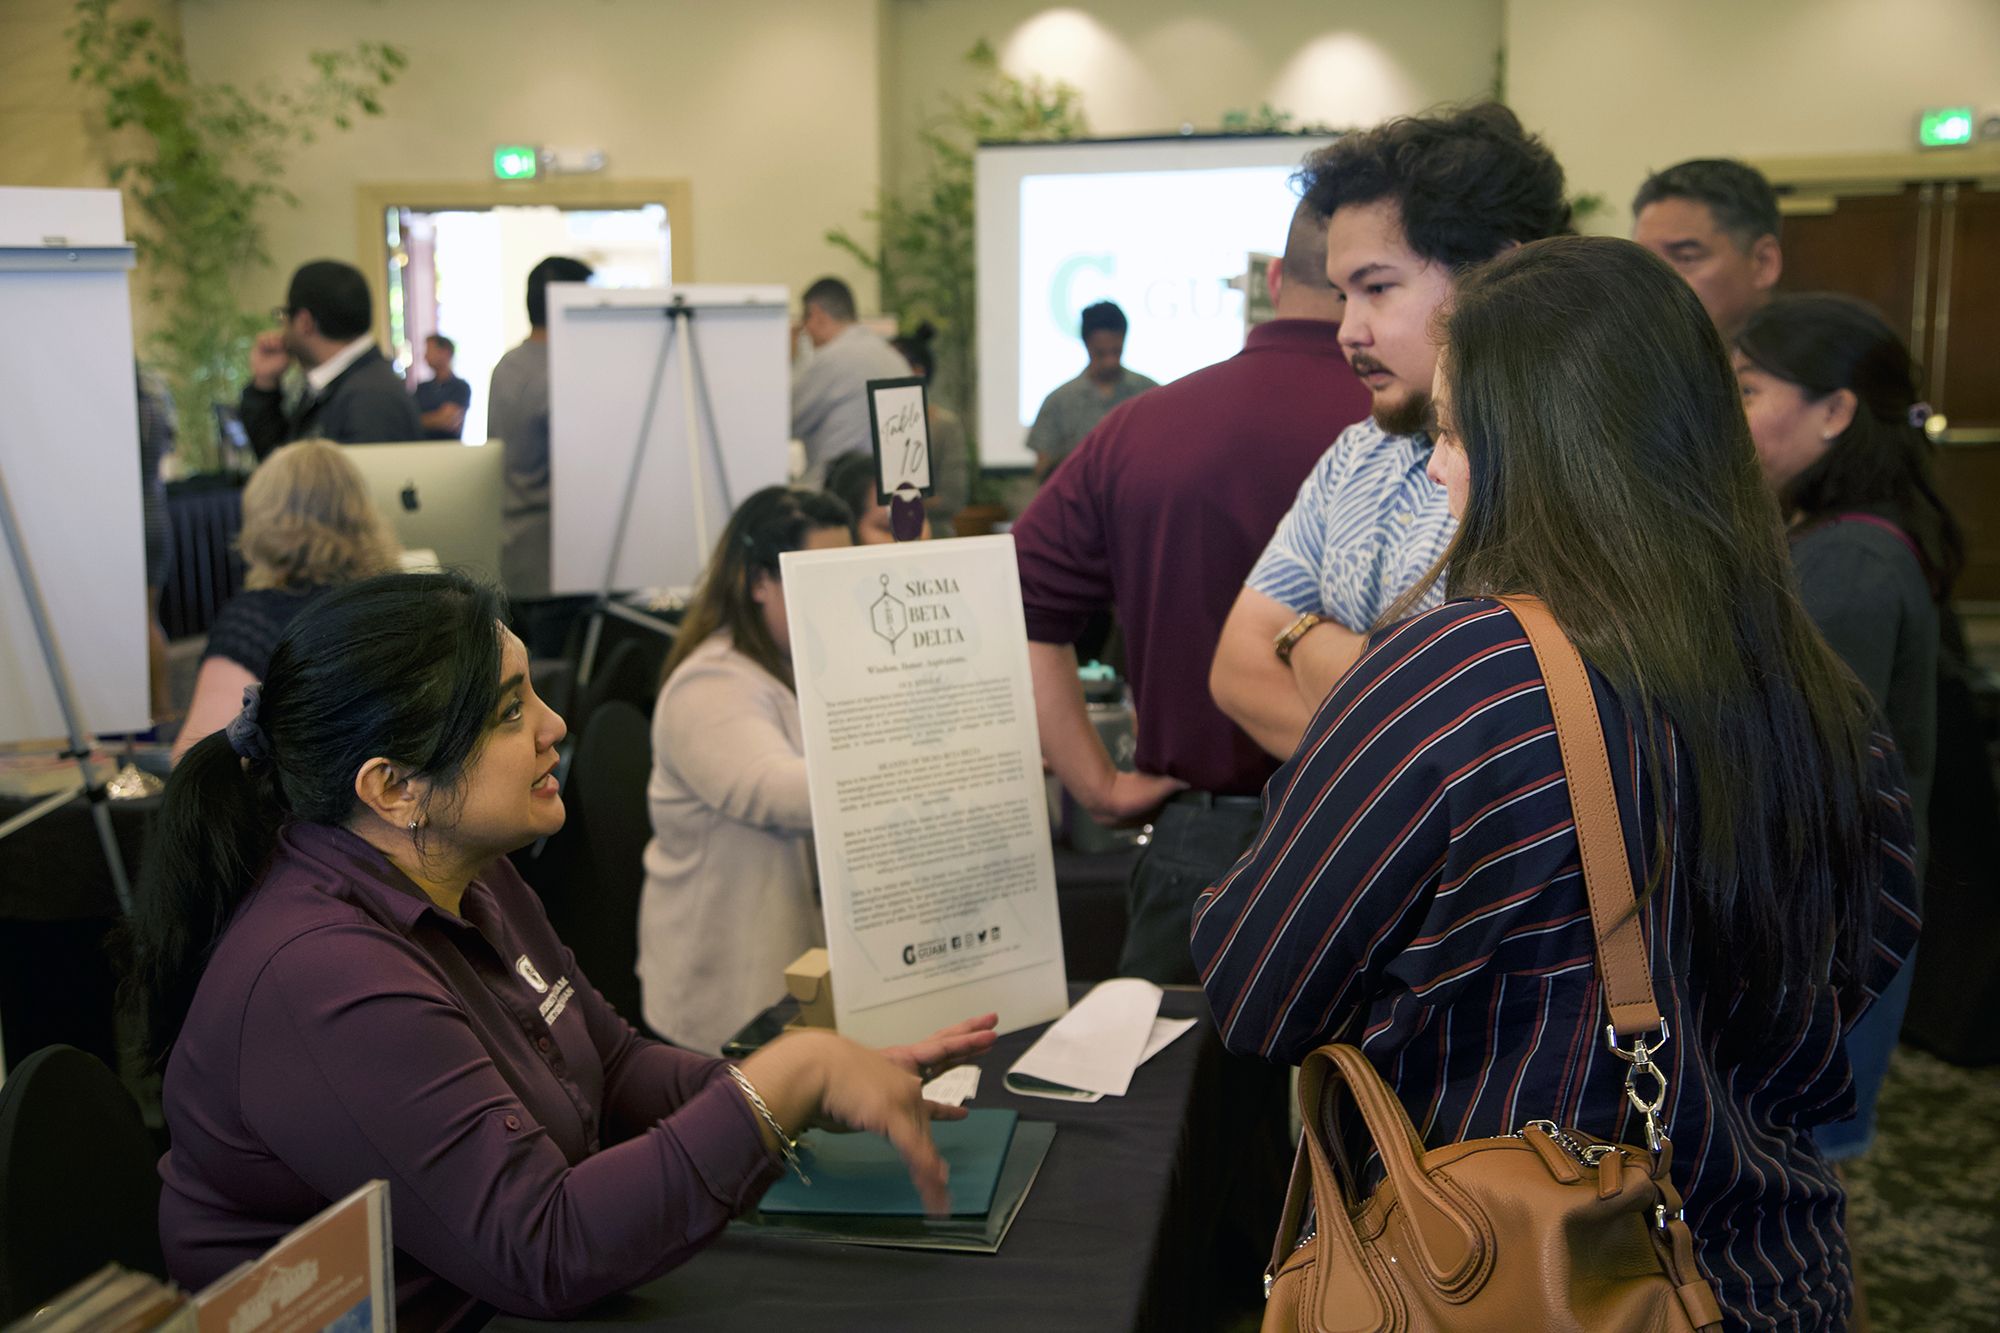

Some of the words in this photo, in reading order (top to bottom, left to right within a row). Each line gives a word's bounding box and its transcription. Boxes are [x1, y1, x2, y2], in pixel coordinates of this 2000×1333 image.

[883, 402, 921, 443] Table
[906, 578, 960, 597] SIGMA
[909, 604, 951, 623] BETA
[913, 627, 965, 648] DELTA
[918, 944, 947, 959] GUAM
